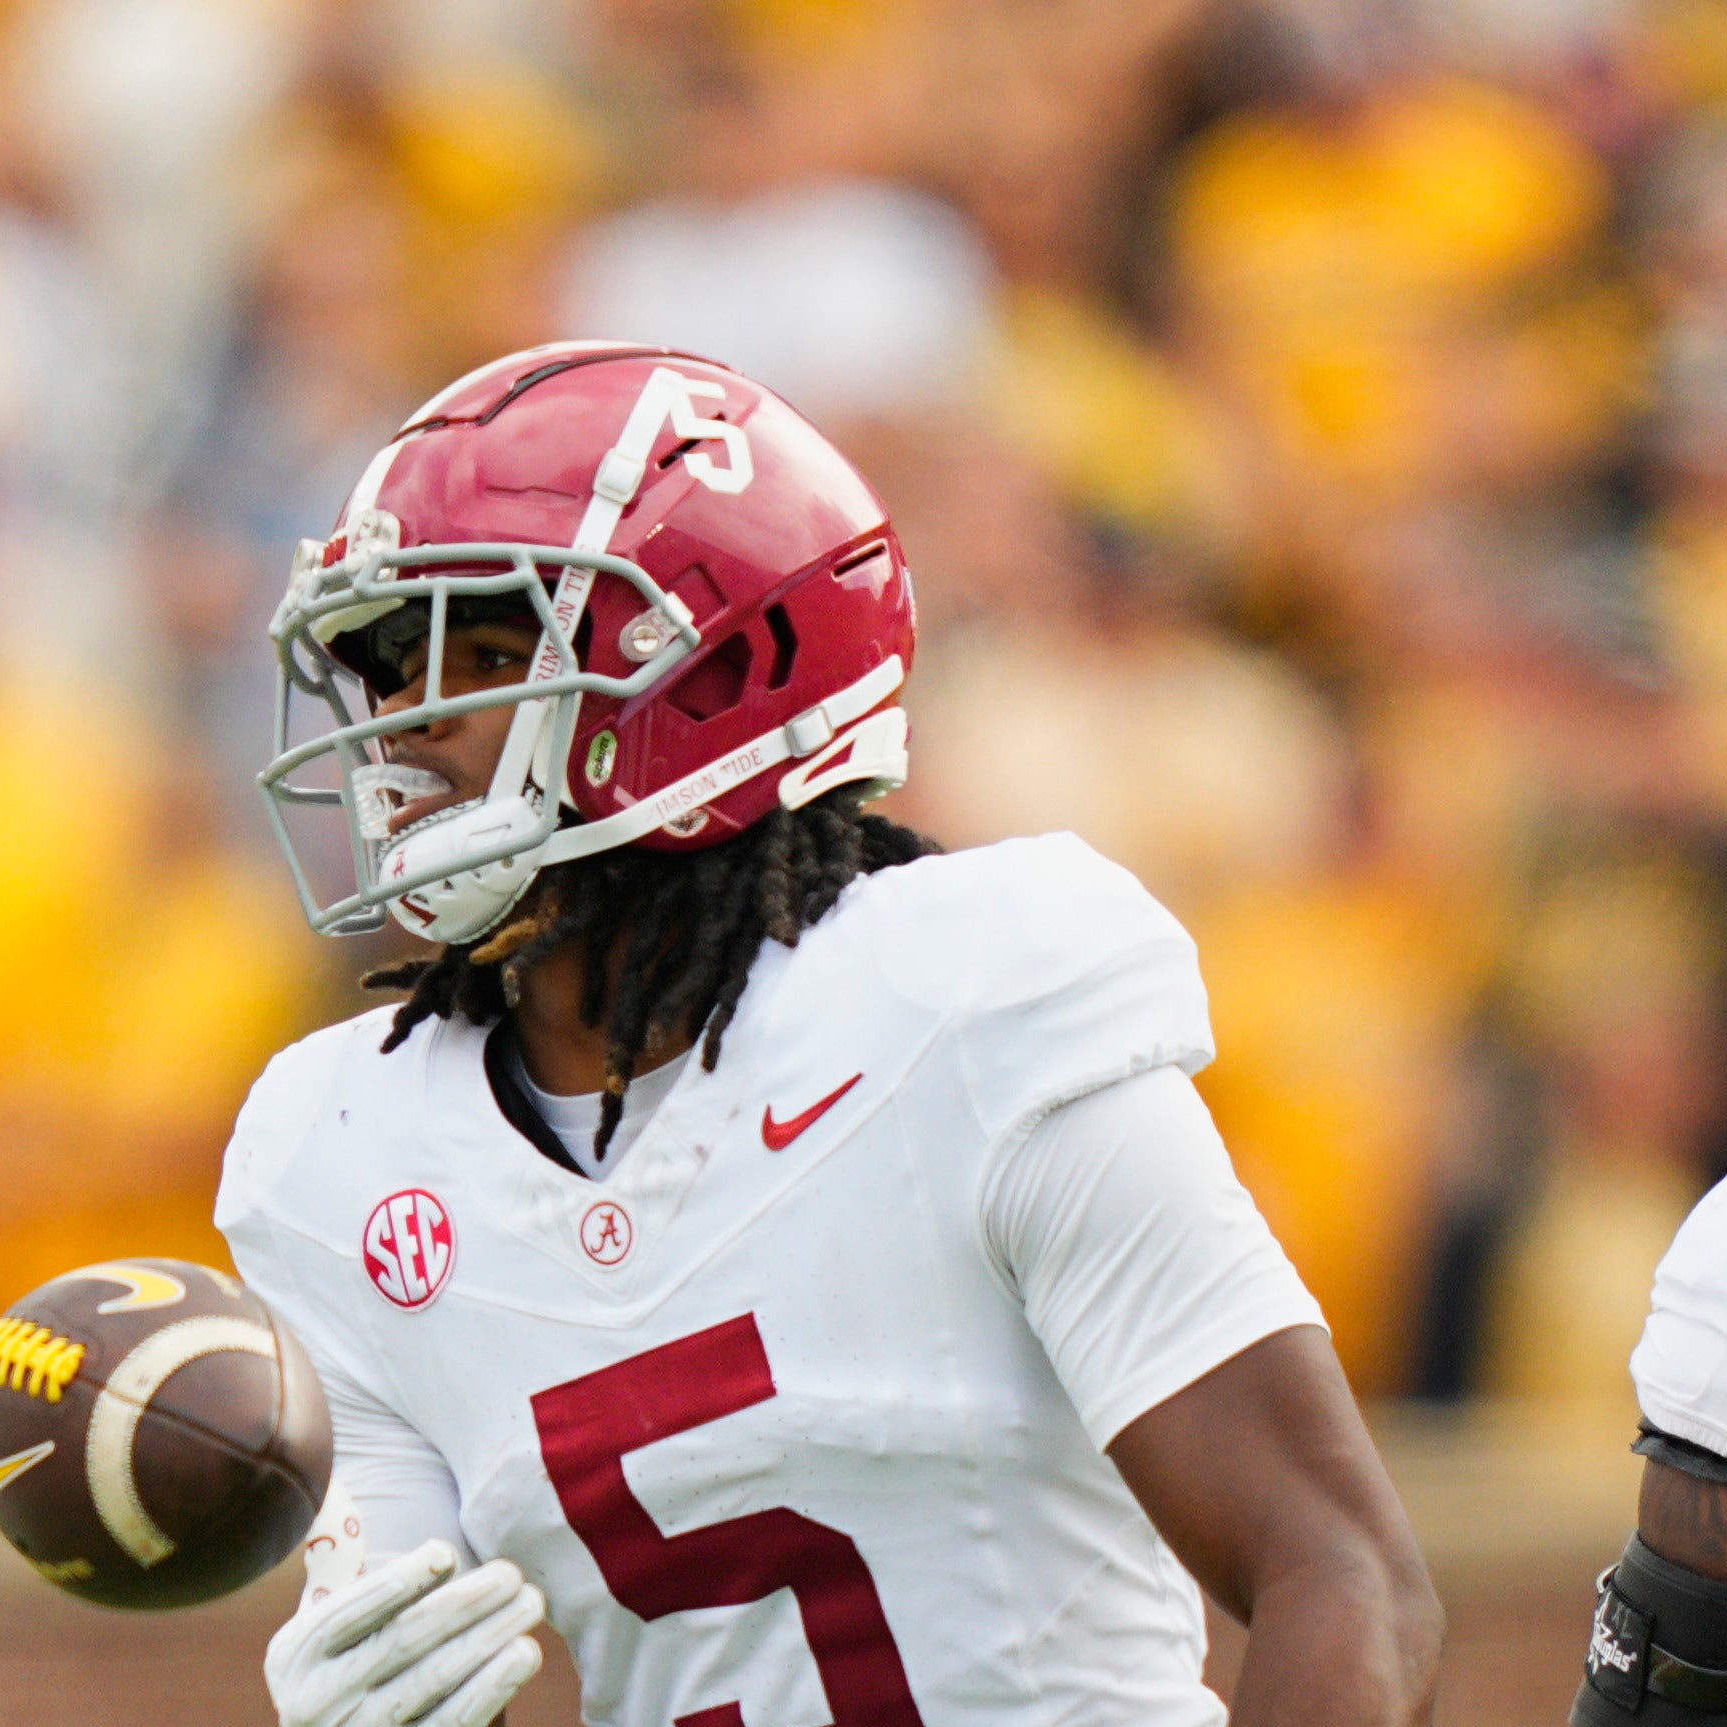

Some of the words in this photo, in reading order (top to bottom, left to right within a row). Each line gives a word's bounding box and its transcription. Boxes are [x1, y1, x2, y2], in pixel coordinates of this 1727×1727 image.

[669, 376, 755, 495] 5
[720, 746, 764, 780] TIDE
[365, 1190, 450, 1304] SEC
